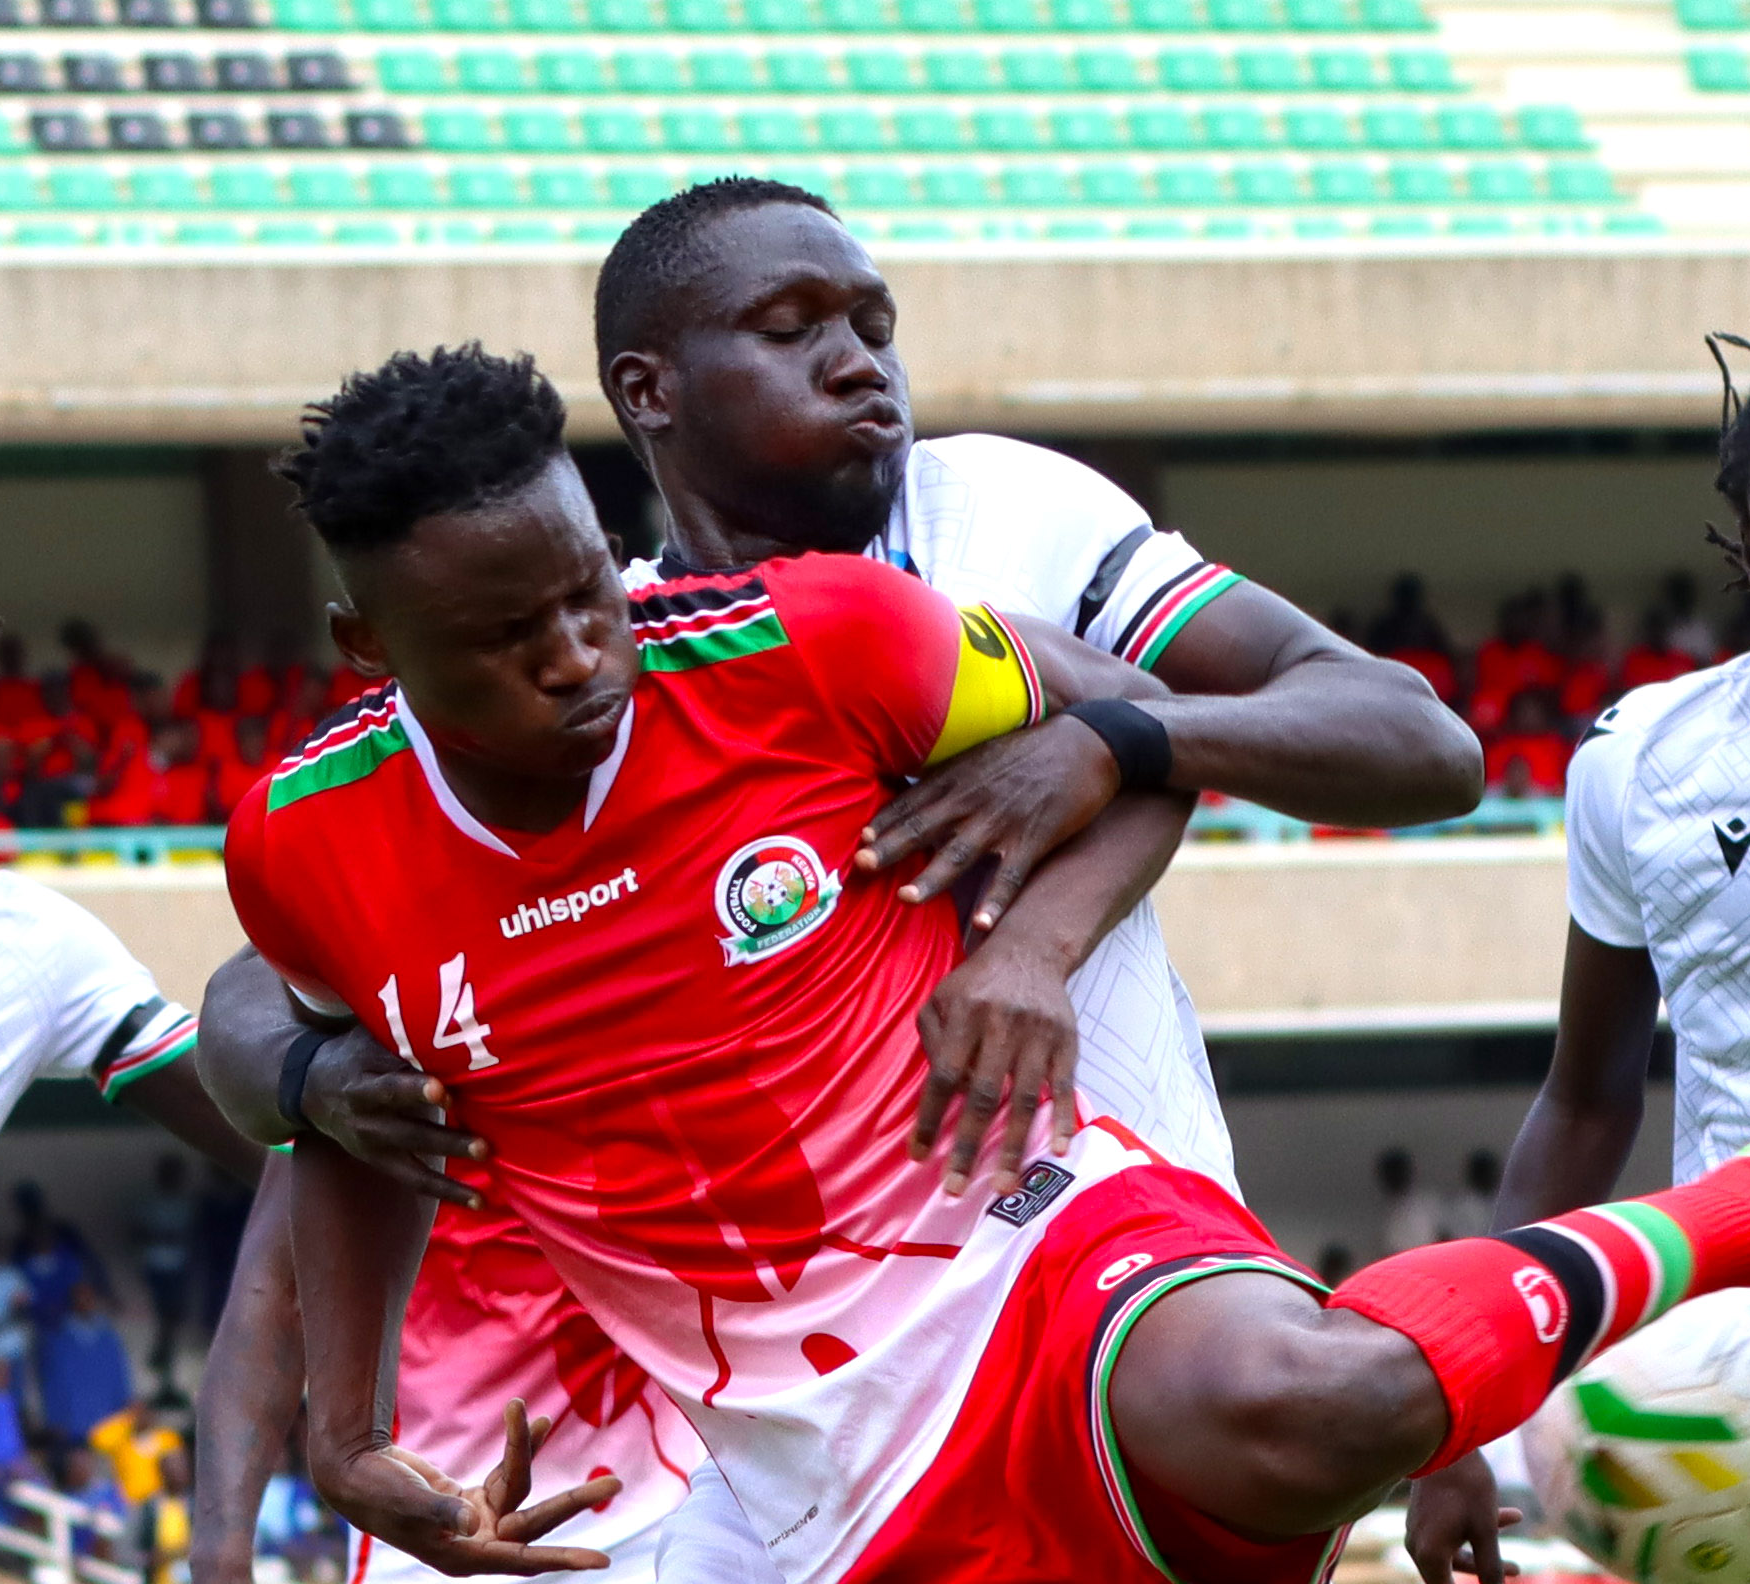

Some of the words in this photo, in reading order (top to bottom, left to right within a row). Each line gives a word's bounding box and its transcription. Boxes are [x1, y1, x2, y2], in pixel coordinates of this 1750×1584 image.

[790, 854, 817, 891] KENYA
[499, 867, 640, 939] uhlsport
[728, 877, 758, 934] FOOTBALL
[756, 906, 823, 950] FEDERATION
[377, 951, 500, 1073] 14
